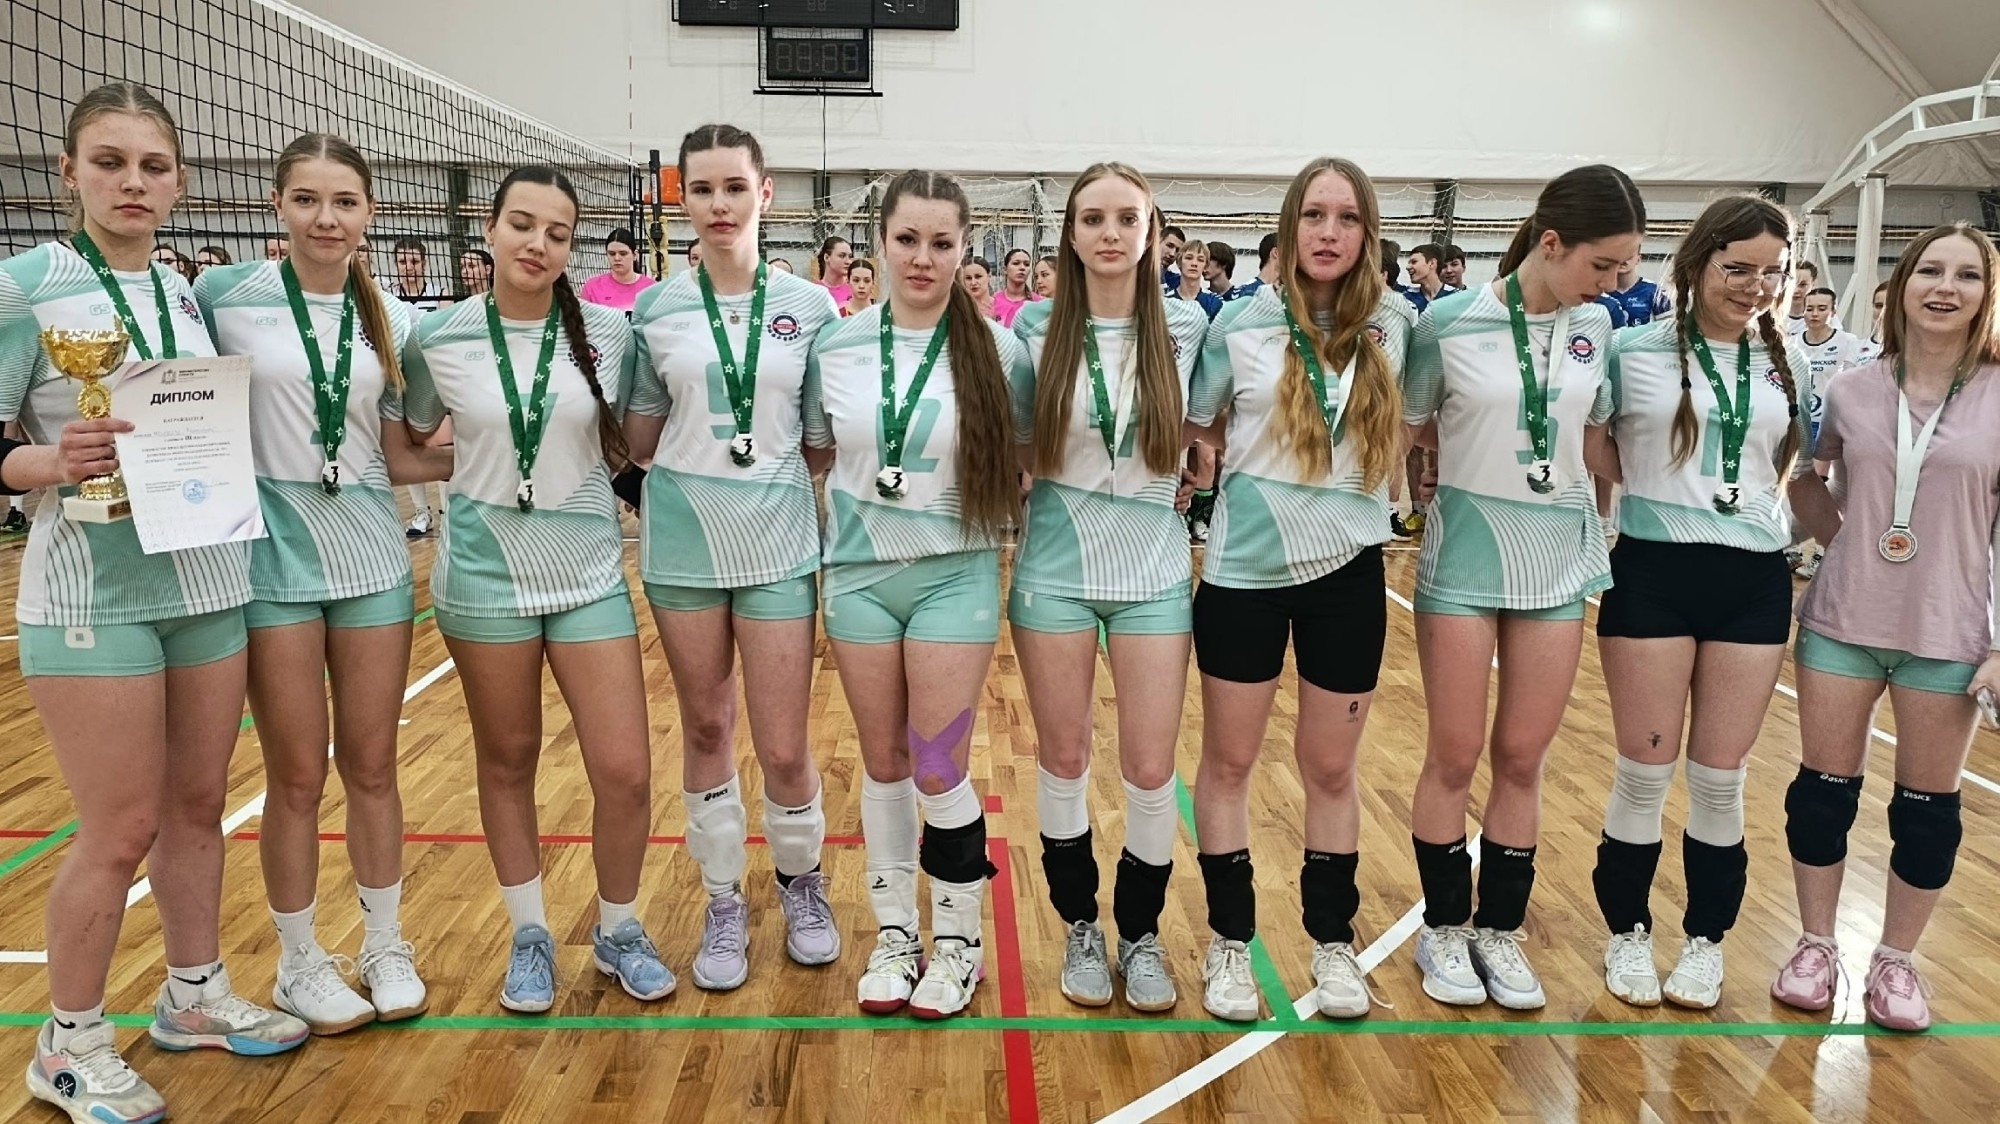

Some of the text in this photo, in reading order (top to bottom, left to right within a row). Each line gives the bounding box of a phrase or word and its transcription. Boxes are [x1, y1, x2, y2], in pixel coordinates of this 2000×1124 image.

[150, 389, 214, 406] ДИПЛОМ
[1515, 387, 1562, 464] 5
[741, 438, 753, 456] 3
[330, 466, 339, 485] 3
[891, 471, 904, 489] 3
[1538, 464, 1551, 483] 3
[525, 484, 534, 502] 3
[1727, 487, 1740, 505] 3
